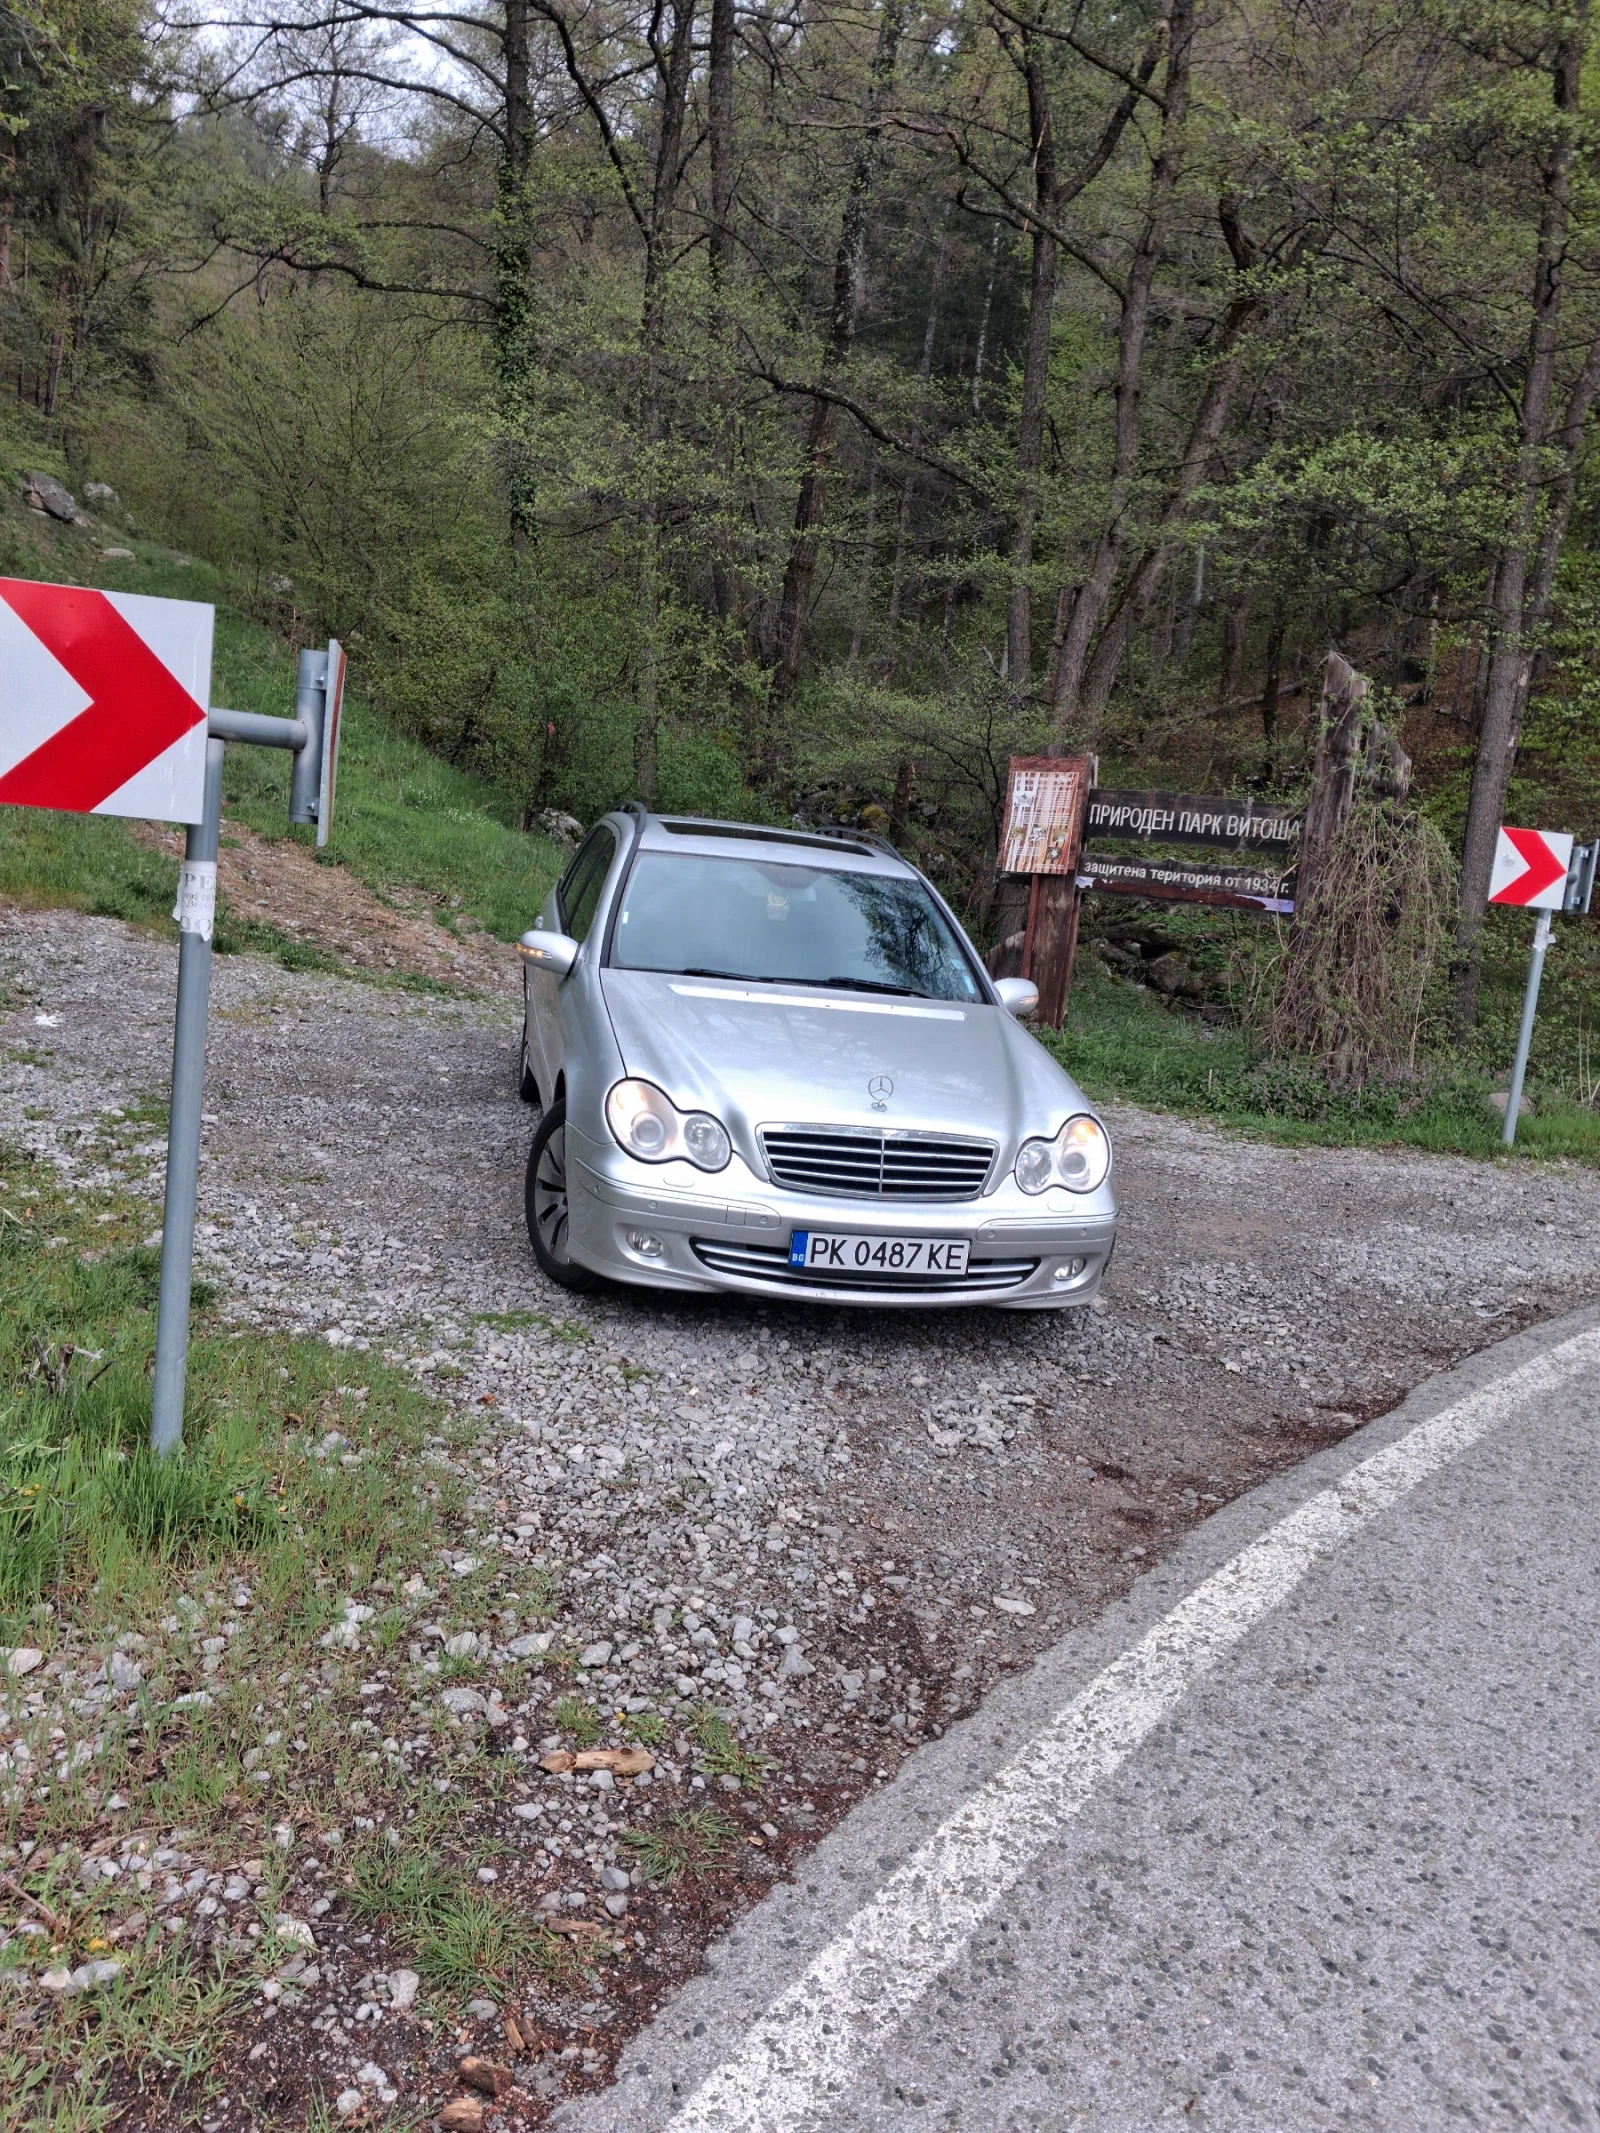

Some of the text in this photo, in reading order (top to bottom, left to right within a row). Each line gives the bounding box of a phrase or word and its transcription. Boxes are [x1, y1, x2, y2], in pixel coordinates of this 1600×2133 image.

[1089, 803, 1175, 835] ПРИРОДЕН
[1178, 811, 1223, 836] ПАРК
[1226, 815, 1300, 840] ВИТОША
[1084, 862, 1147, 879] защитена
[1149, 868, 1222, 889] територия
[1224, 876, 1242, 888] от
[1244, 876, 1279, 893] 1934
[1280, 882, 1290, 894] г.
[792, 1252, 805, 1262] BG
[809, 1237, 965, 1270] PK 0487 KE
